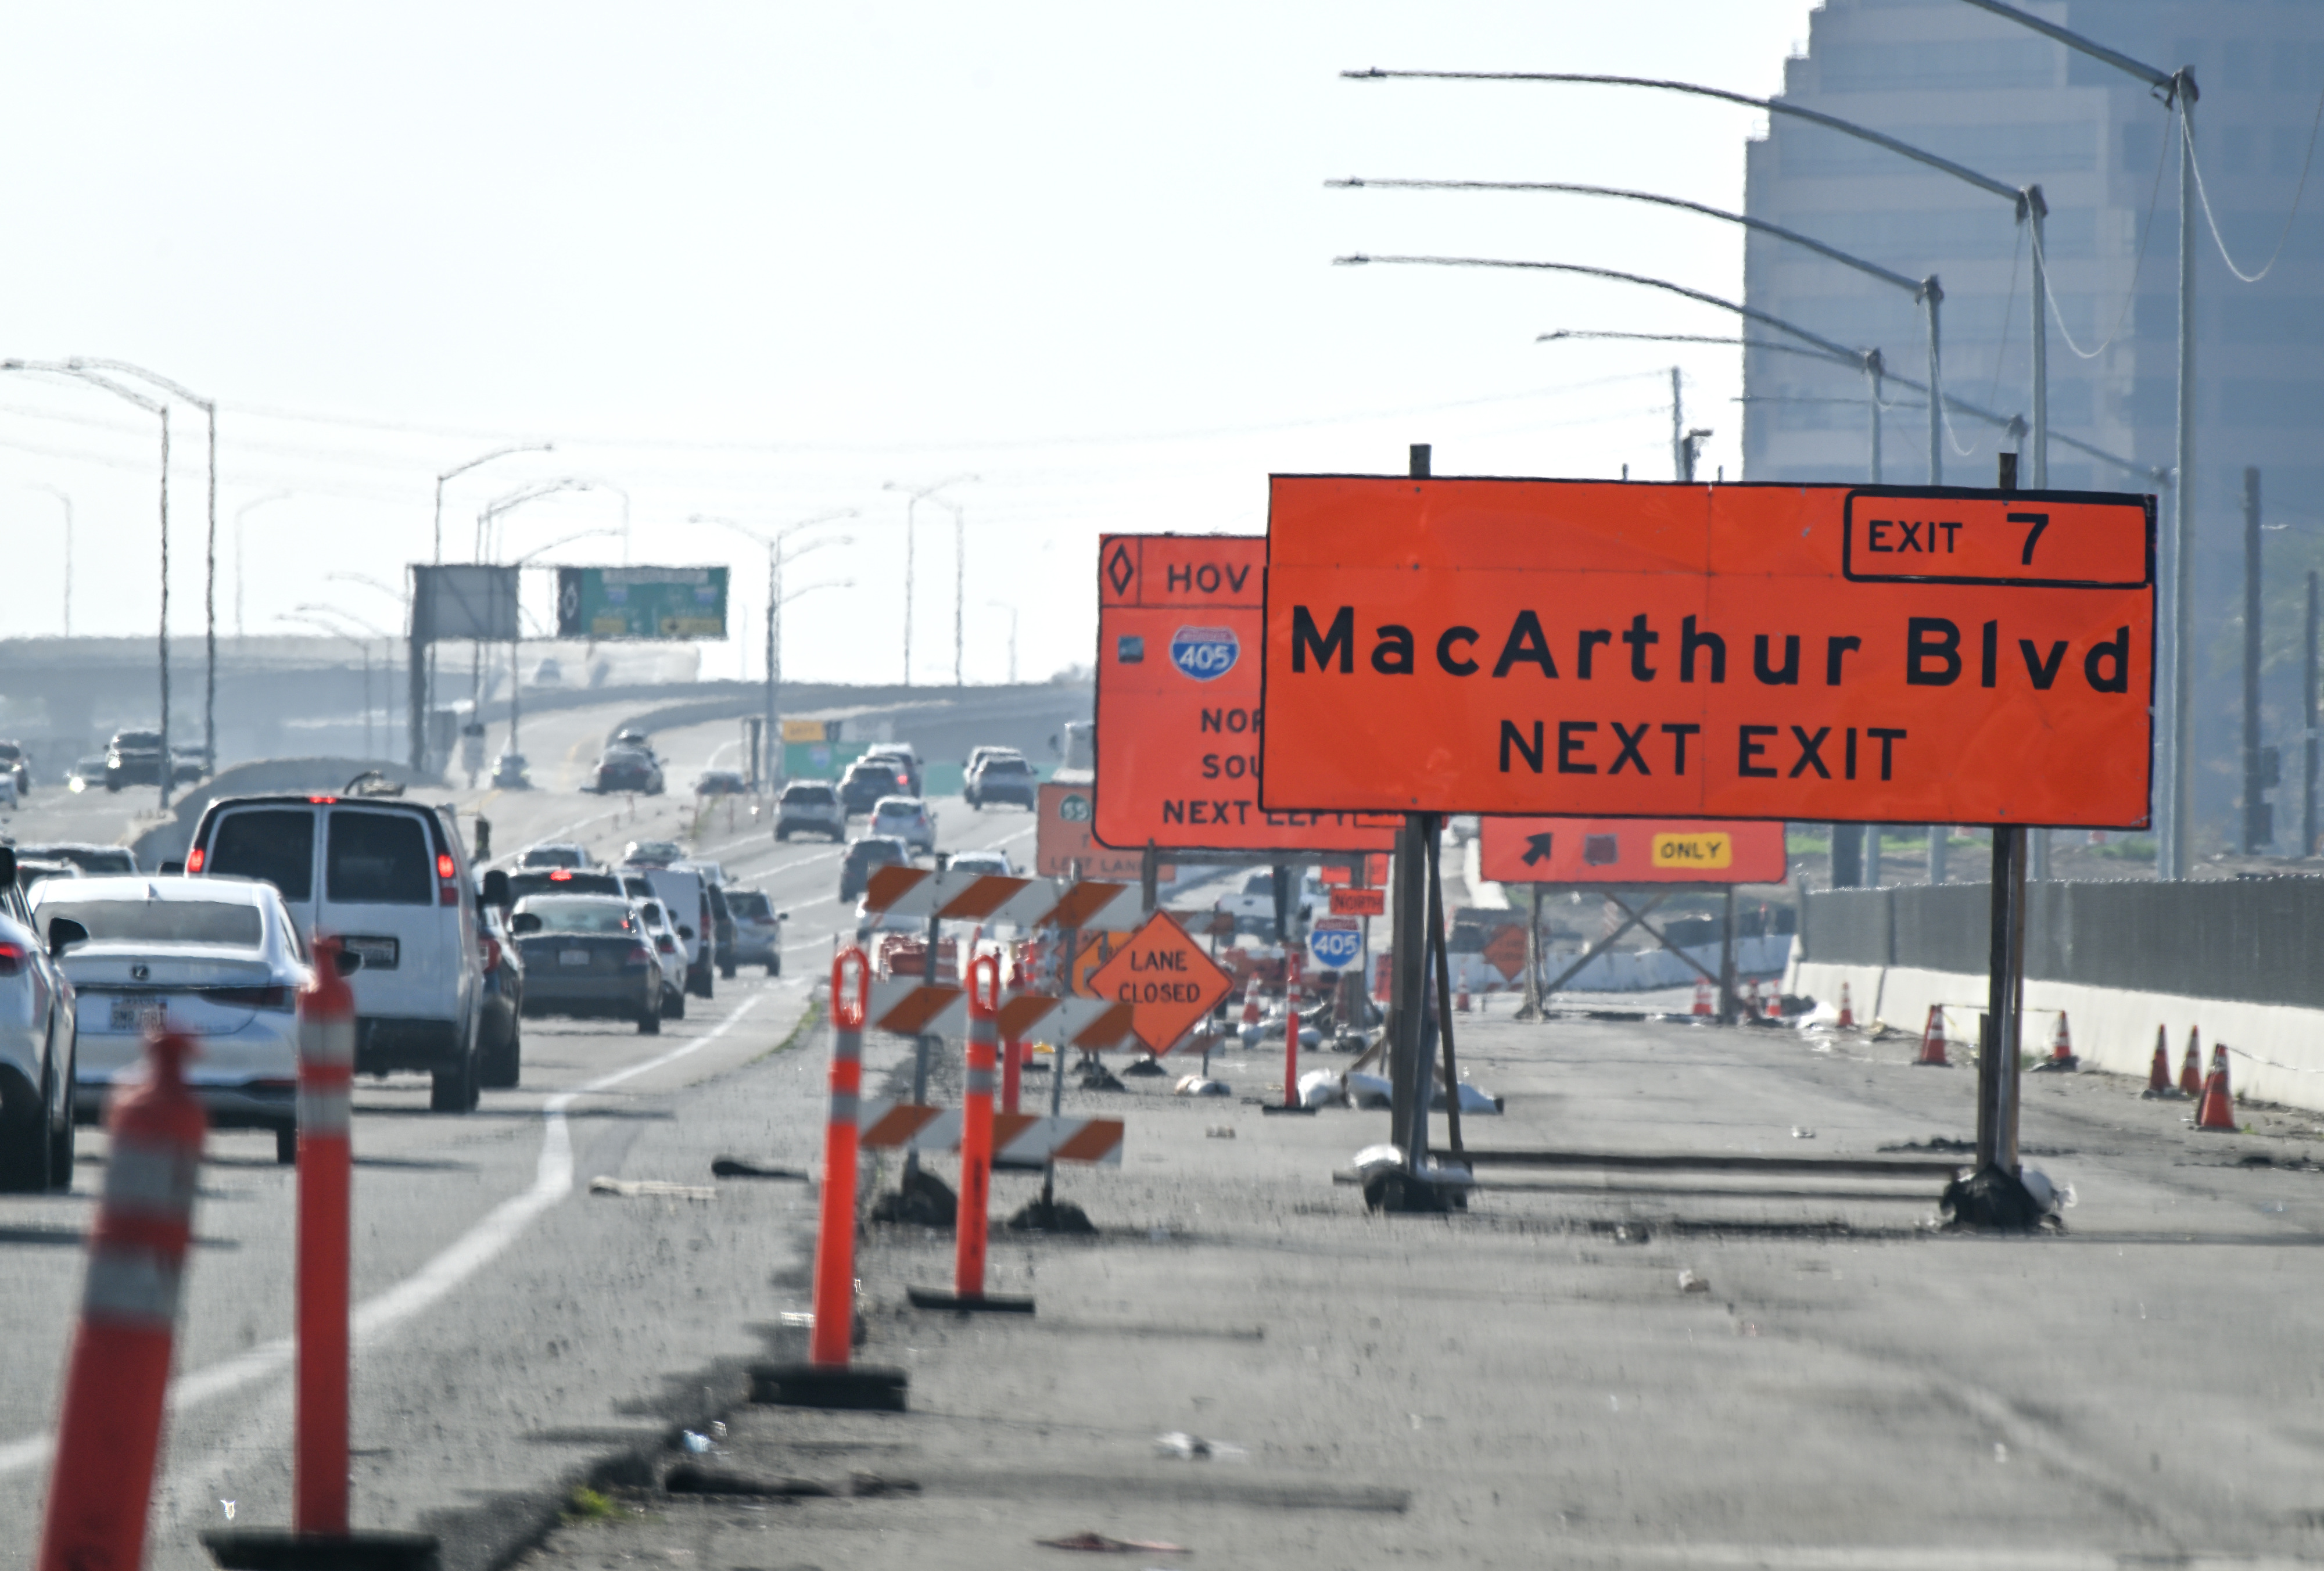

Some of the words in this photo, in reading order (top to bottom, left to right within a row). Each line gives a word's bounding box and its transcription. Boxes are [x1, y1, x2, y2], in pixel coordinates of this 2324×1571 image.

[1869, 521, 1963, 554] EXIT
[2006, 513, 2049, 566] 7
[1167, 563, 1251, 594] HOV
[1179, 644, 1231, 670] 405
[1292, 605, 1862, 686] MacArthur
[1906, 616, 2130, 694] Blvd
[1499, 720, 1701, 776] NEXT
[1739, 725, 1907, 781] EXIT
[1163, 800, 1252, 825] NEXT
[1660, 841, 1722, 859] ONLY
[1336, 895, 1382, 910] NORTH
[1314, 934, 1357, 955] 405
[1131, 950, 1188, 972] LANE
[1118, 982, 1201, 1004] CLOSED
